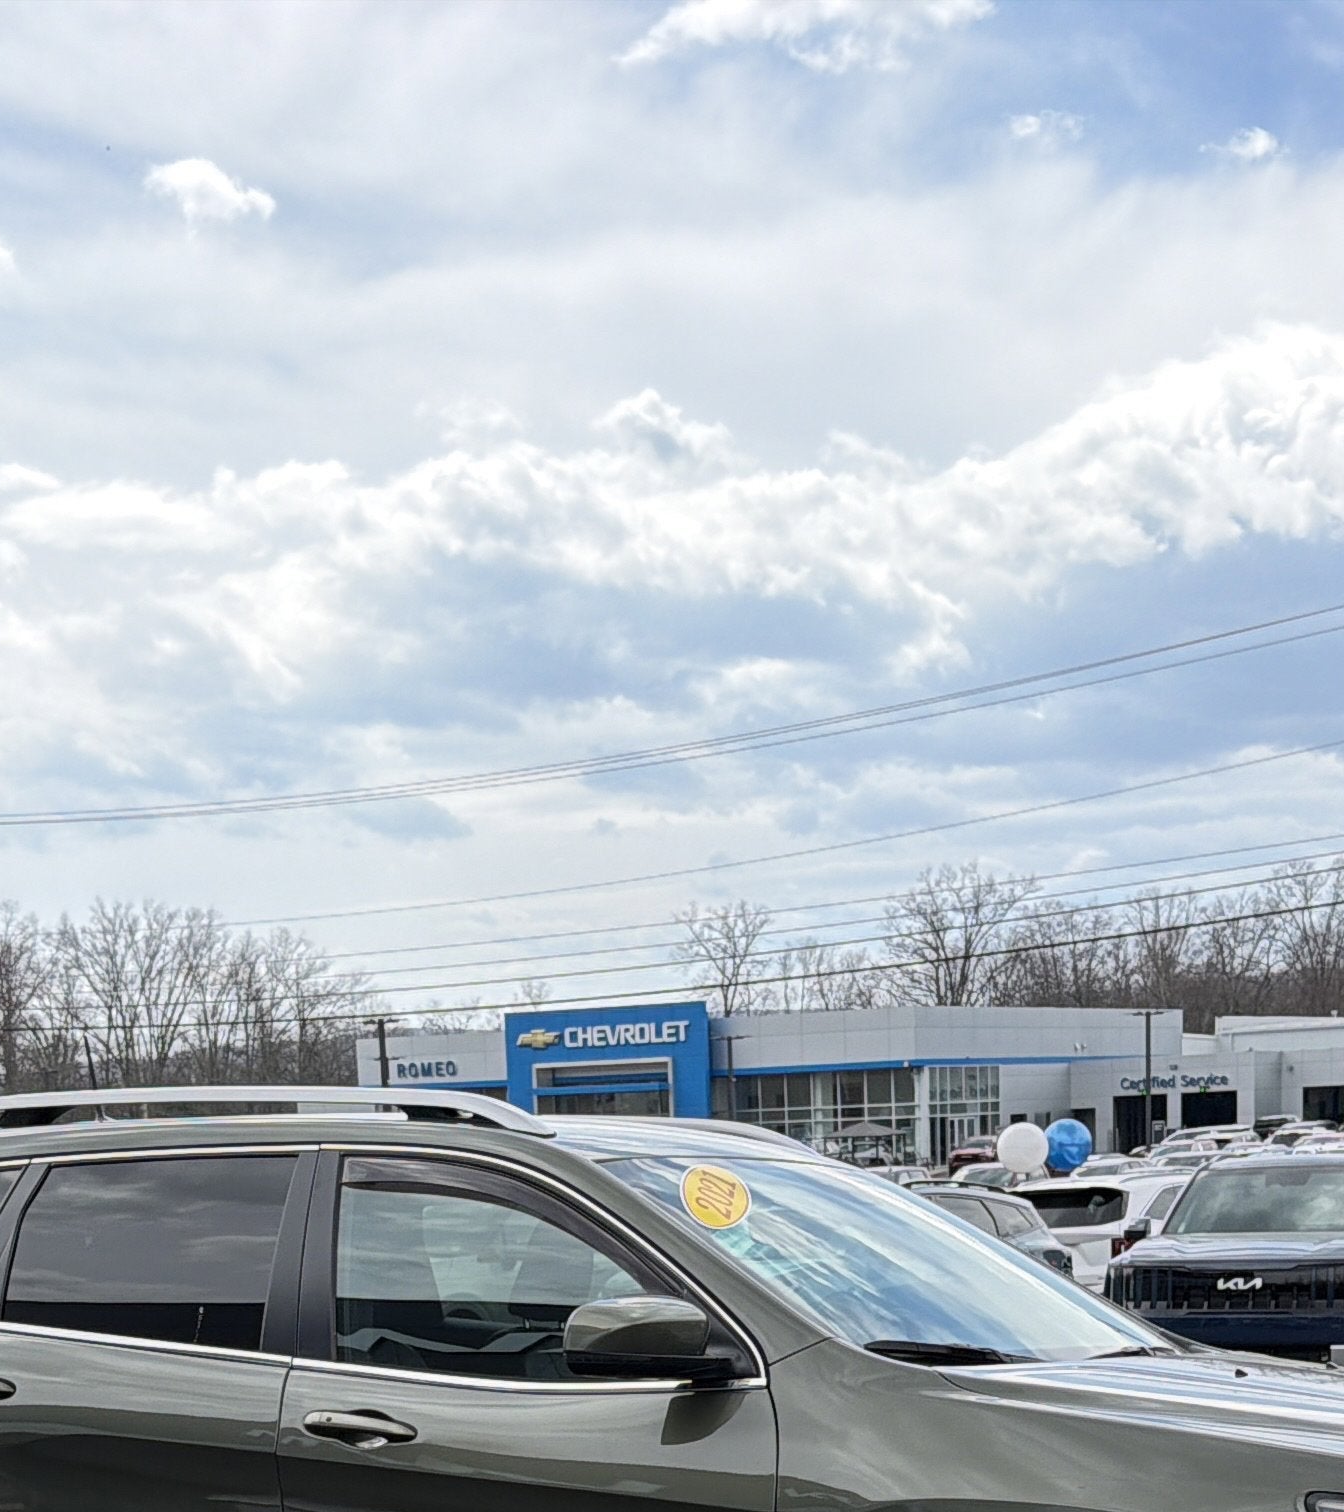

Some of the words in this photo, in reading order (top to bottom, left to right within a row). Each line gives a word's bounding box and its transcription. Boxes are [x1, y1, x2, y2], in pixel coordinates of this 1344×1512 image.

[564, 1021, 689, 1048] CHEVROLET
[396, 1060, 457, 1079] ROMEO
[1120, 1075, 1176, 1090] Certfied
[1181, 1073, 1229, 1087] Service
[695, 1170, 737, 1221] 2021
[1217, 1277, 1263, 1291] KIA
